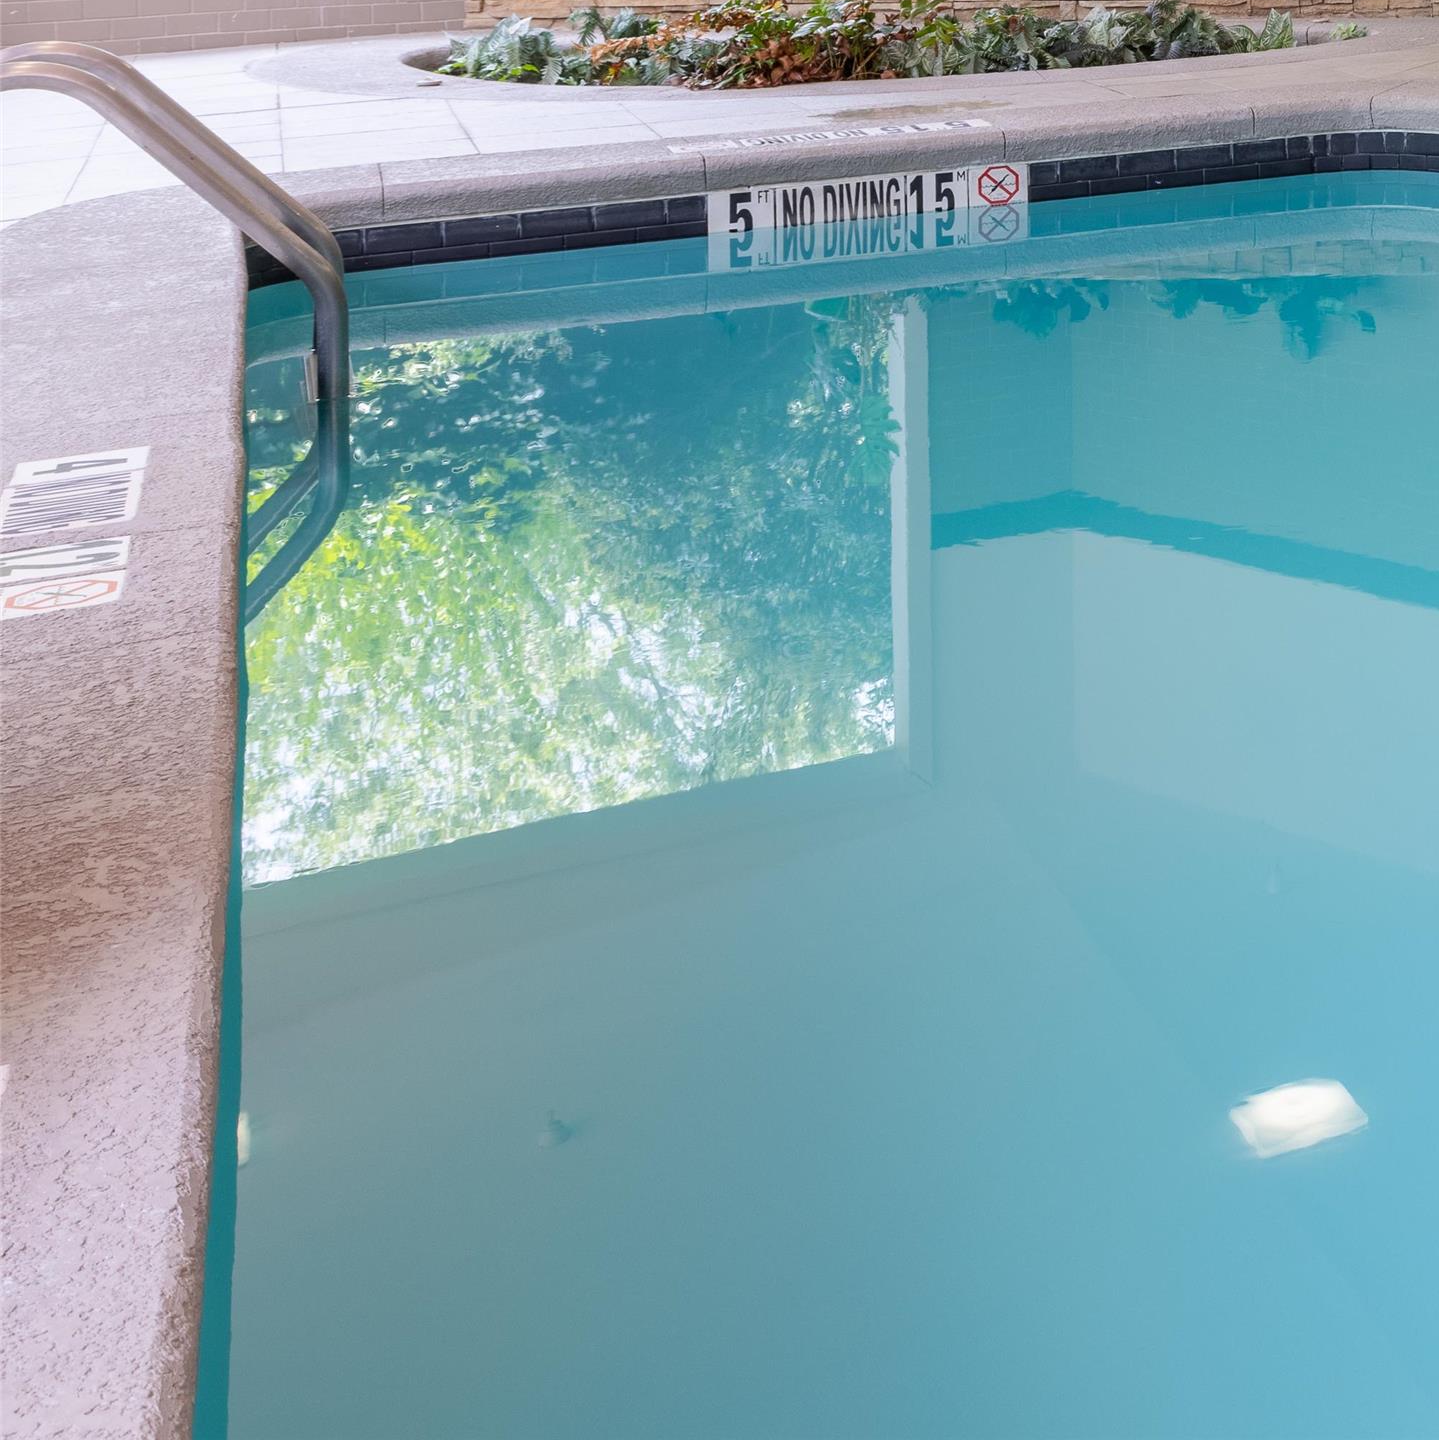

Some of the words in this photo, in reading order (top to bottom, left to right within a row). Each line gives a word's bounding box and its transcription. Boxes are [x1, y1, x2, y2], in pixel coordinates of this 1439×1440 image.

[729, 193, 753, 233] 5
[758, 191, 769, 204] FT
[783, 187, 815, 228] NO
[823, 178, 901, 224] DIVING
[957, 171, 966, 181] M
[33, 458, 128, 476] 4
